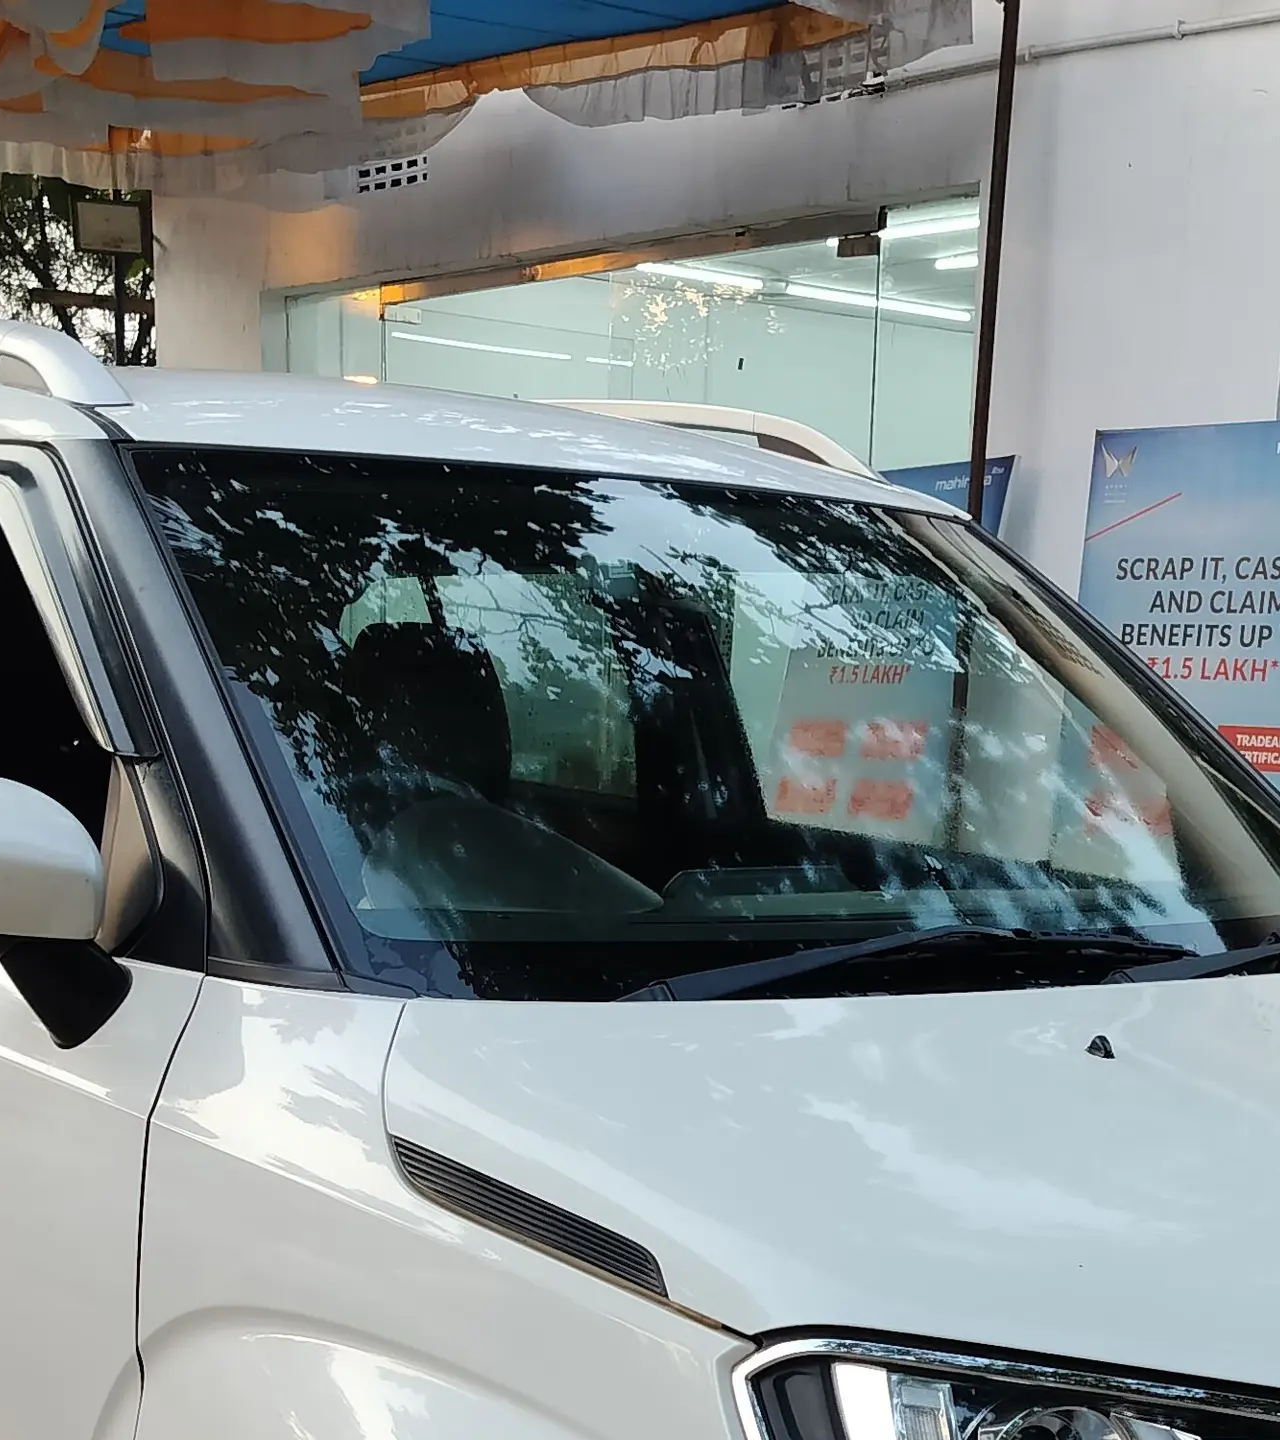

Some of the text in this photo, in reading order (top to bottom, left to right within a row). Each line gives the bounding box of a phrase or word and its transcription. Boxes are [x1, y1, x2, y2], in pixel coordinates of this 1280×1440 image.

[1116, 557, 1194, 580] SCRAP
[1201, 557, 1224, 584] IT,
[1149, 590, 1203, 613] AND
[1121, 623, 1232, 647] BENEFITS
[1239, 625, 1273, 648] UP
